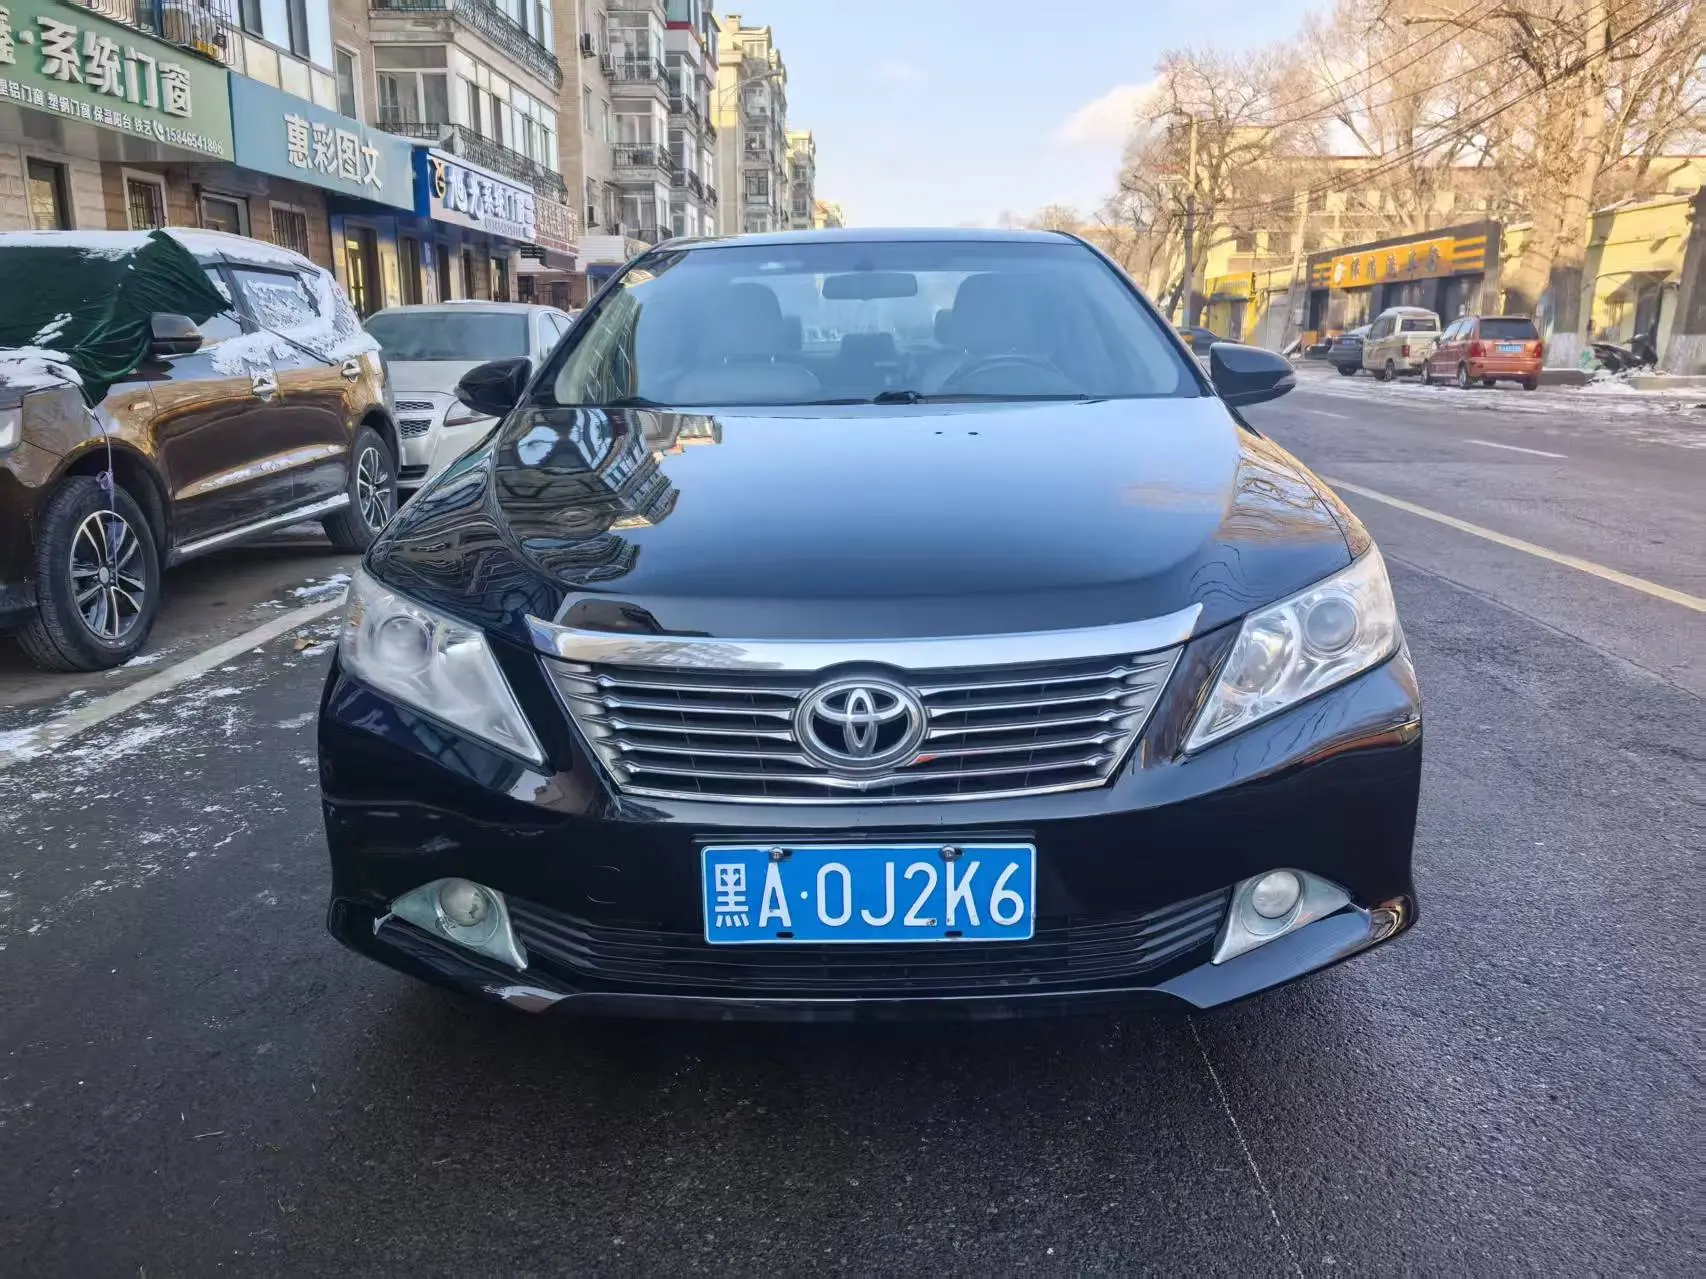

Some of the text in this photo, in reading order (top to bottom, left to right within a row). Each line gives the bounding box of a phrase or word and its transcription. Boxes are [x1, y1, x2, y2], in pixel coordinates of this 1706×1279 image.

[94, 105, 132, 130] 保温阳台
[283, 113, 383, 190] 惠彩图文
[714, 861, 1025, 928] 黑A·0J2K6
